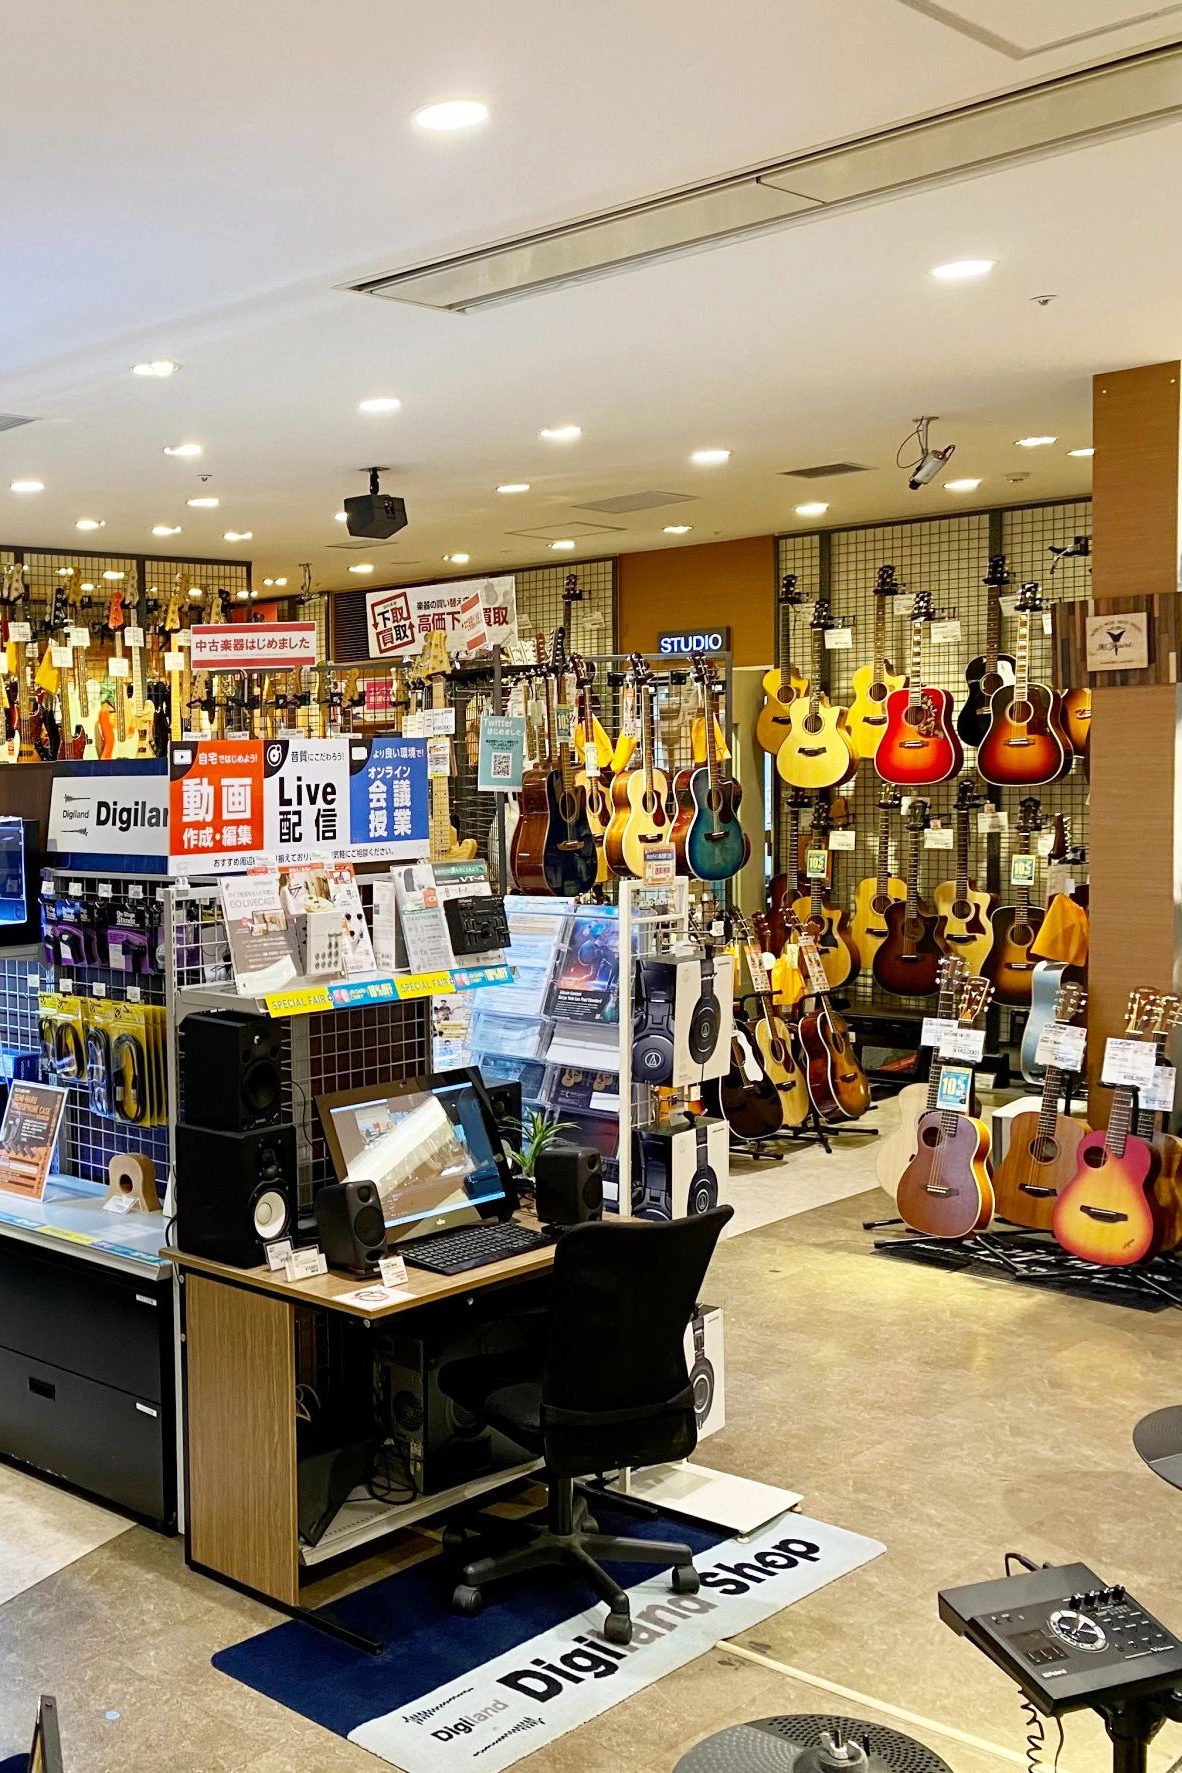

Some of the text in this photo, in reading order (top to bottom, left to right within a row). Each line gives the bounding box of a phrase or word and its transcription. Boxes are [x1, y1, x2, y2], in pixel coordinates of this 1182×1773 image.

[377, 605, 405, 629] 下取
[417, 610, 461, 634] 高価下
[195, 637, 310, 652] 中古楽器はじめました
[381, 624, 410, 647] 買取
[660, 633, 723, 653] STUDIO
[483, 718, 513, 728] Twitter
[368, 765, 411, 779] オンライン
[181, 777, 253, 823] 動画
[278, 776, 337, 807] Live
[368, 779, 412, 808] 会議
[62, 809, 90, 820] Digiland
[279, 808, 338, 843] 配信
[369, 809, 412, 838] 授業
[182, 825, 253, 849] 作成・編集
[331, 848, 394, 859] 気軽にご相談ください。
[460, 875, 485, 883] VT-4
[401, 982, 431, 993] SPECIAL
[271, 994, 327, 1010] SPECIAL FAIR
[430, 1698, 510, 1744] Digiland
